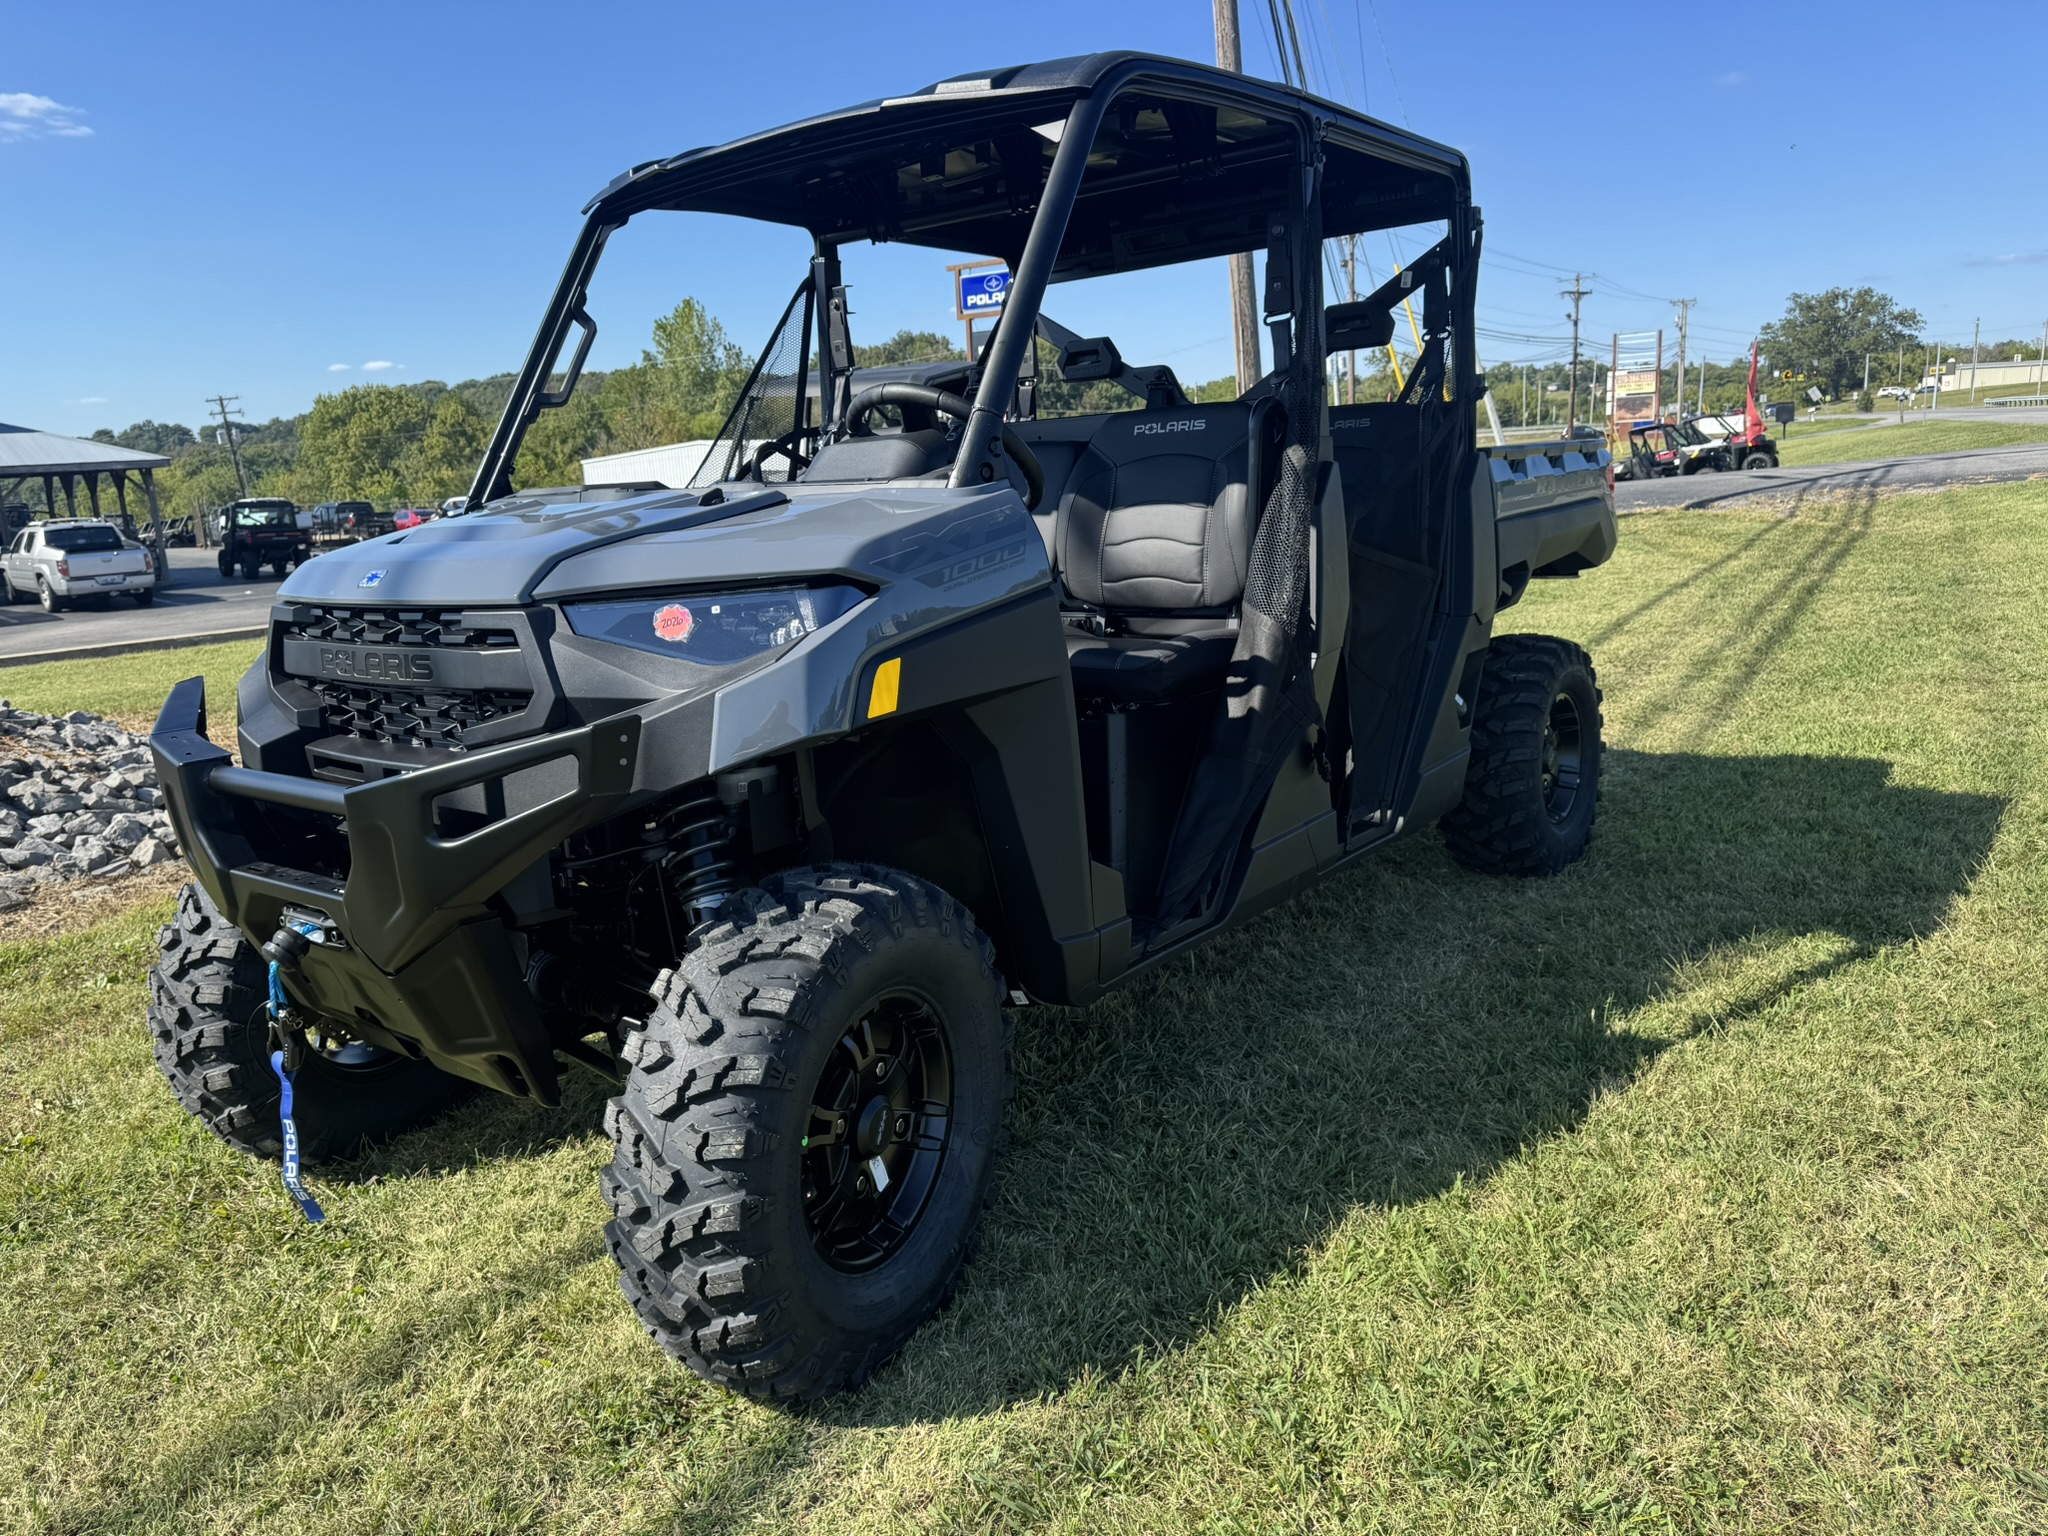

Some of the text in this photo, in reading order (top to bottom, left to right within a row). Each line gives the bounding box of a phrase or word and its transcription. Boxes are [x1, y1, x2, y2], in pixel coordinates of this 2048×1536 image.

[967, 291, 1005, 307] POLA
[1134, 419, 1207, 436] POLARIS
[941, 541, 1026, 582] 1000
[661, 616, 684, 629] 2026
[320, 647, 434, 682] POLARIS
[283, 1119, 310, 1201] POLARIS
